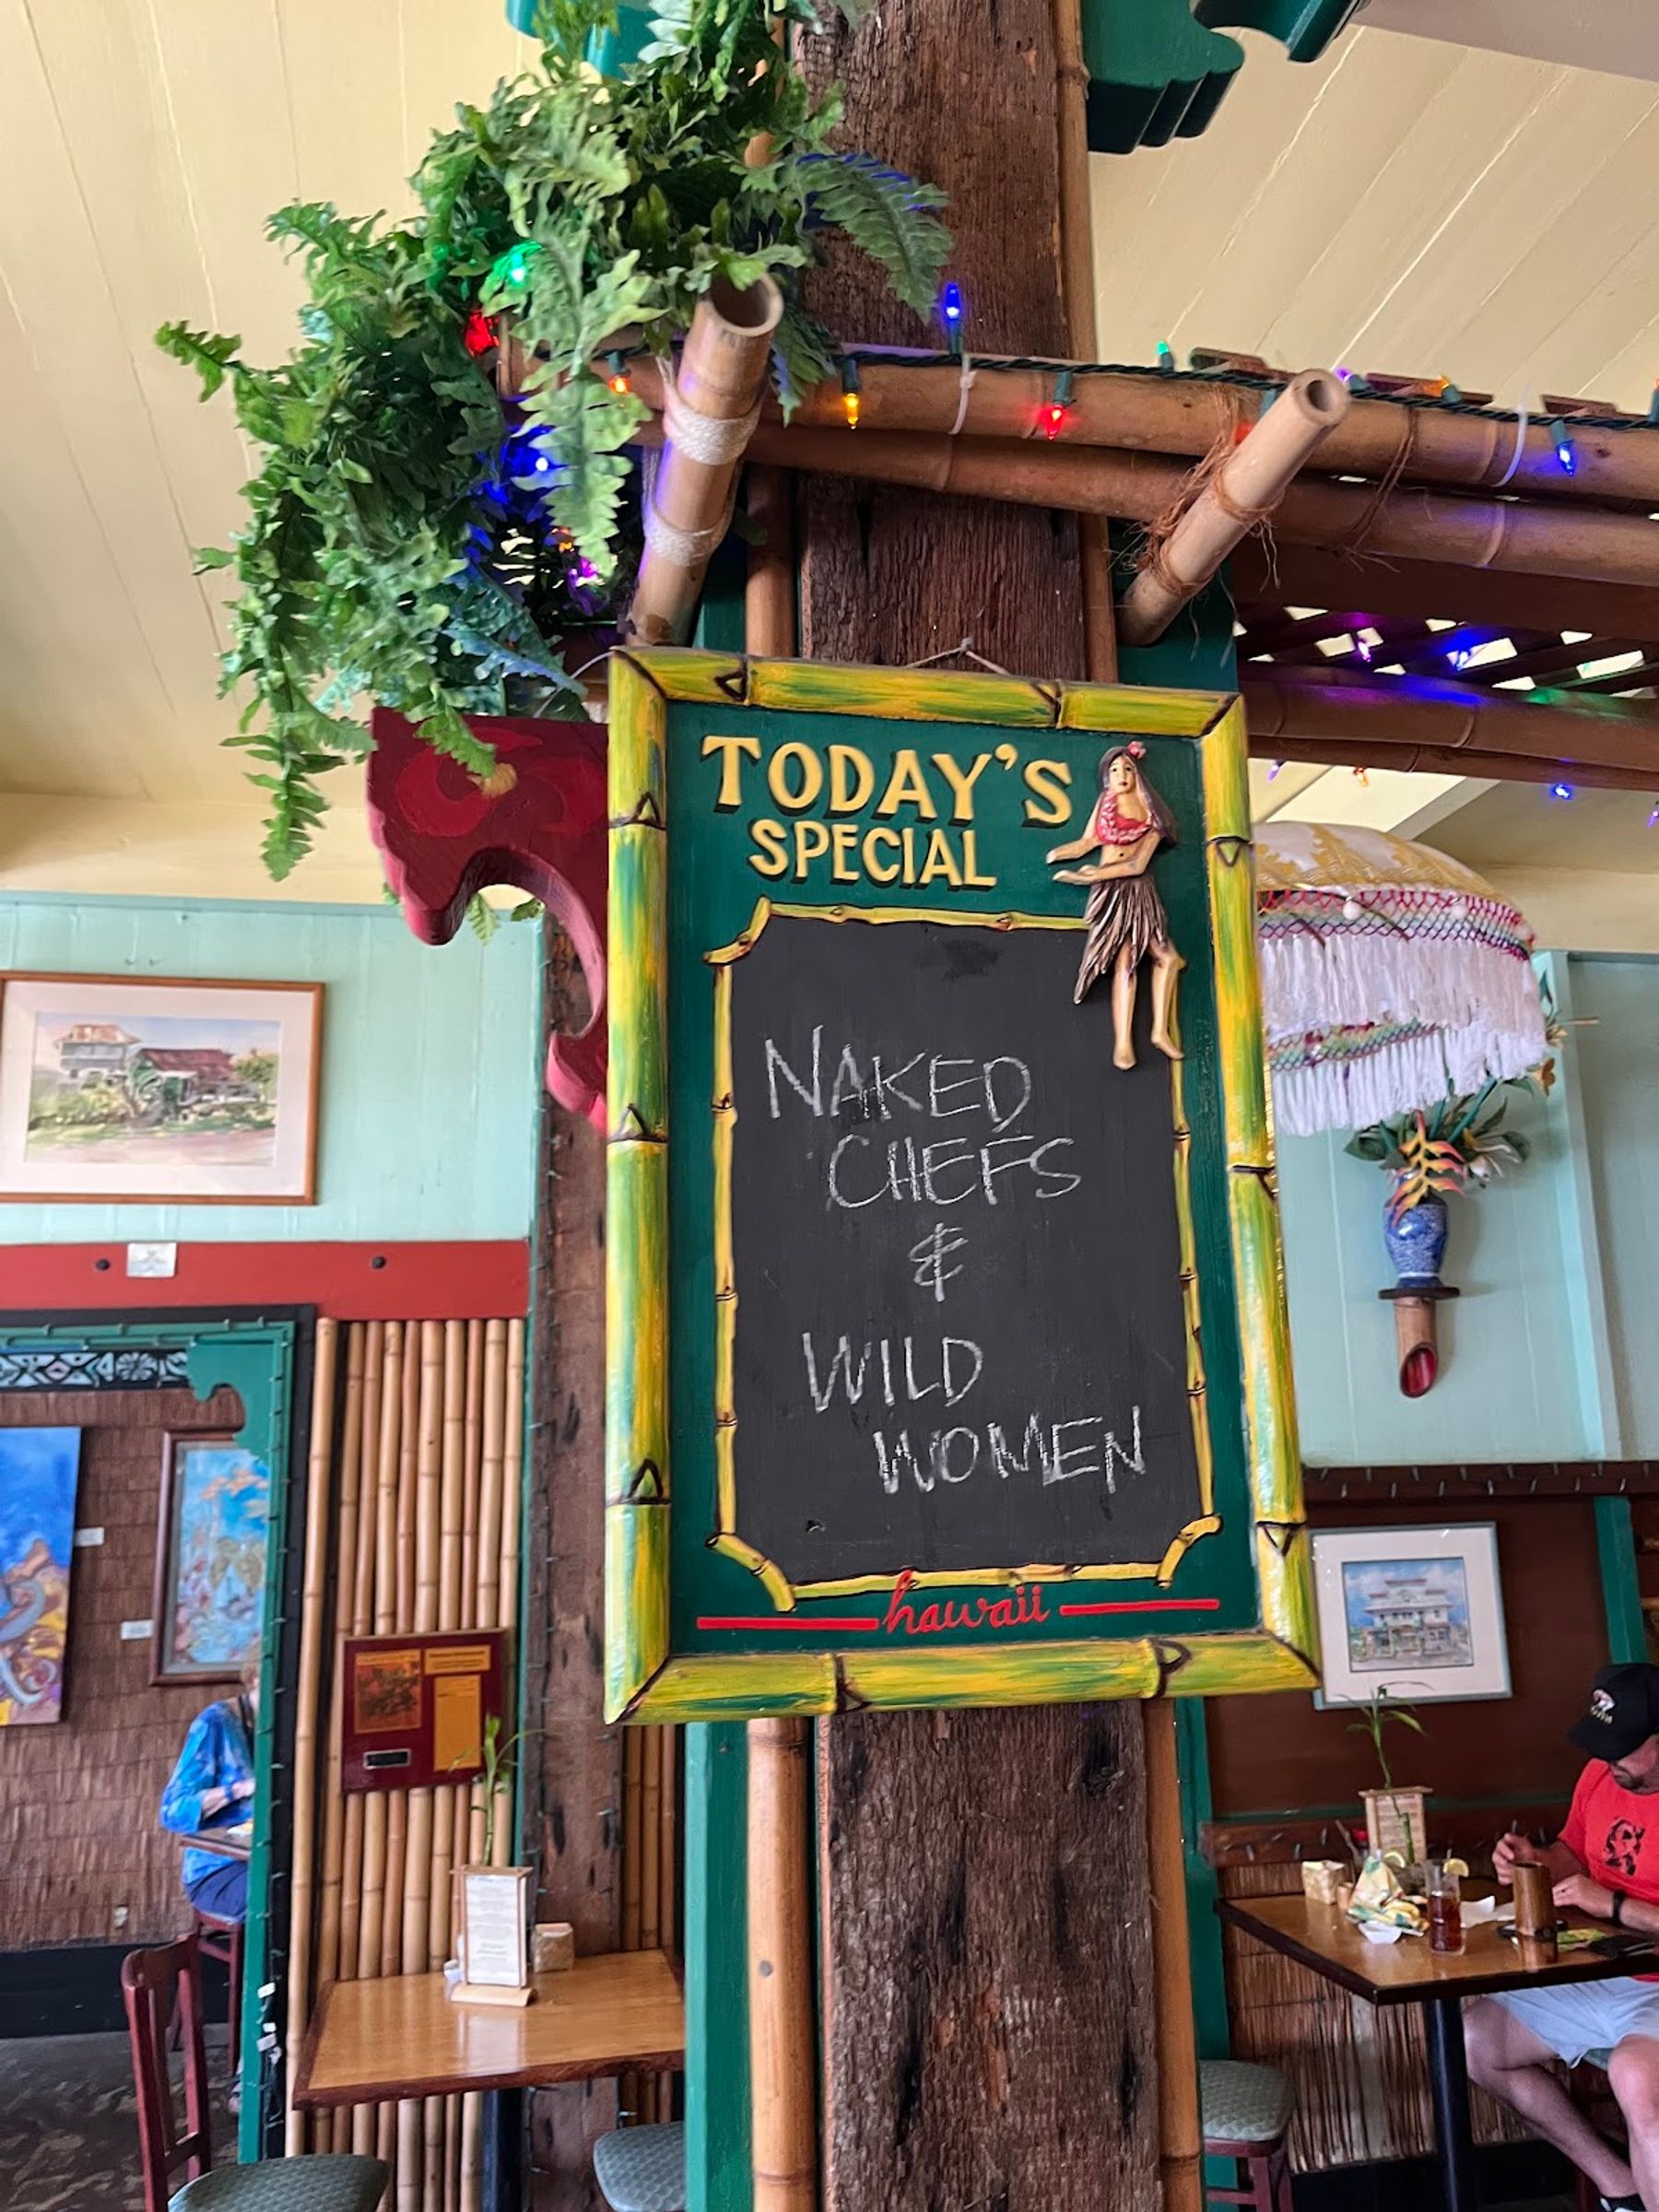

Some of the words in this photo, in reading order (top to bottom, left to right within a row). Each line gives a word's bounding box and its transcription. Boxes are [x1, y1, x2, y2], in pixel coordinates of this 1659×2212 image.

[701, 735, 1073, 825] TODAY'S
[749, 818, 997, 889] SPECIAL
[764, 1025, 1031, 1133] NAKED
[828, 1134, 1081, 1208] CHEFS
[909, 1222, 968, 1302] &
[802, 1332, 983, 1413] WILD
[873, 1406, 1147, 1494] WOMEN
[881, 1569, 1051, 1635] hawaii
